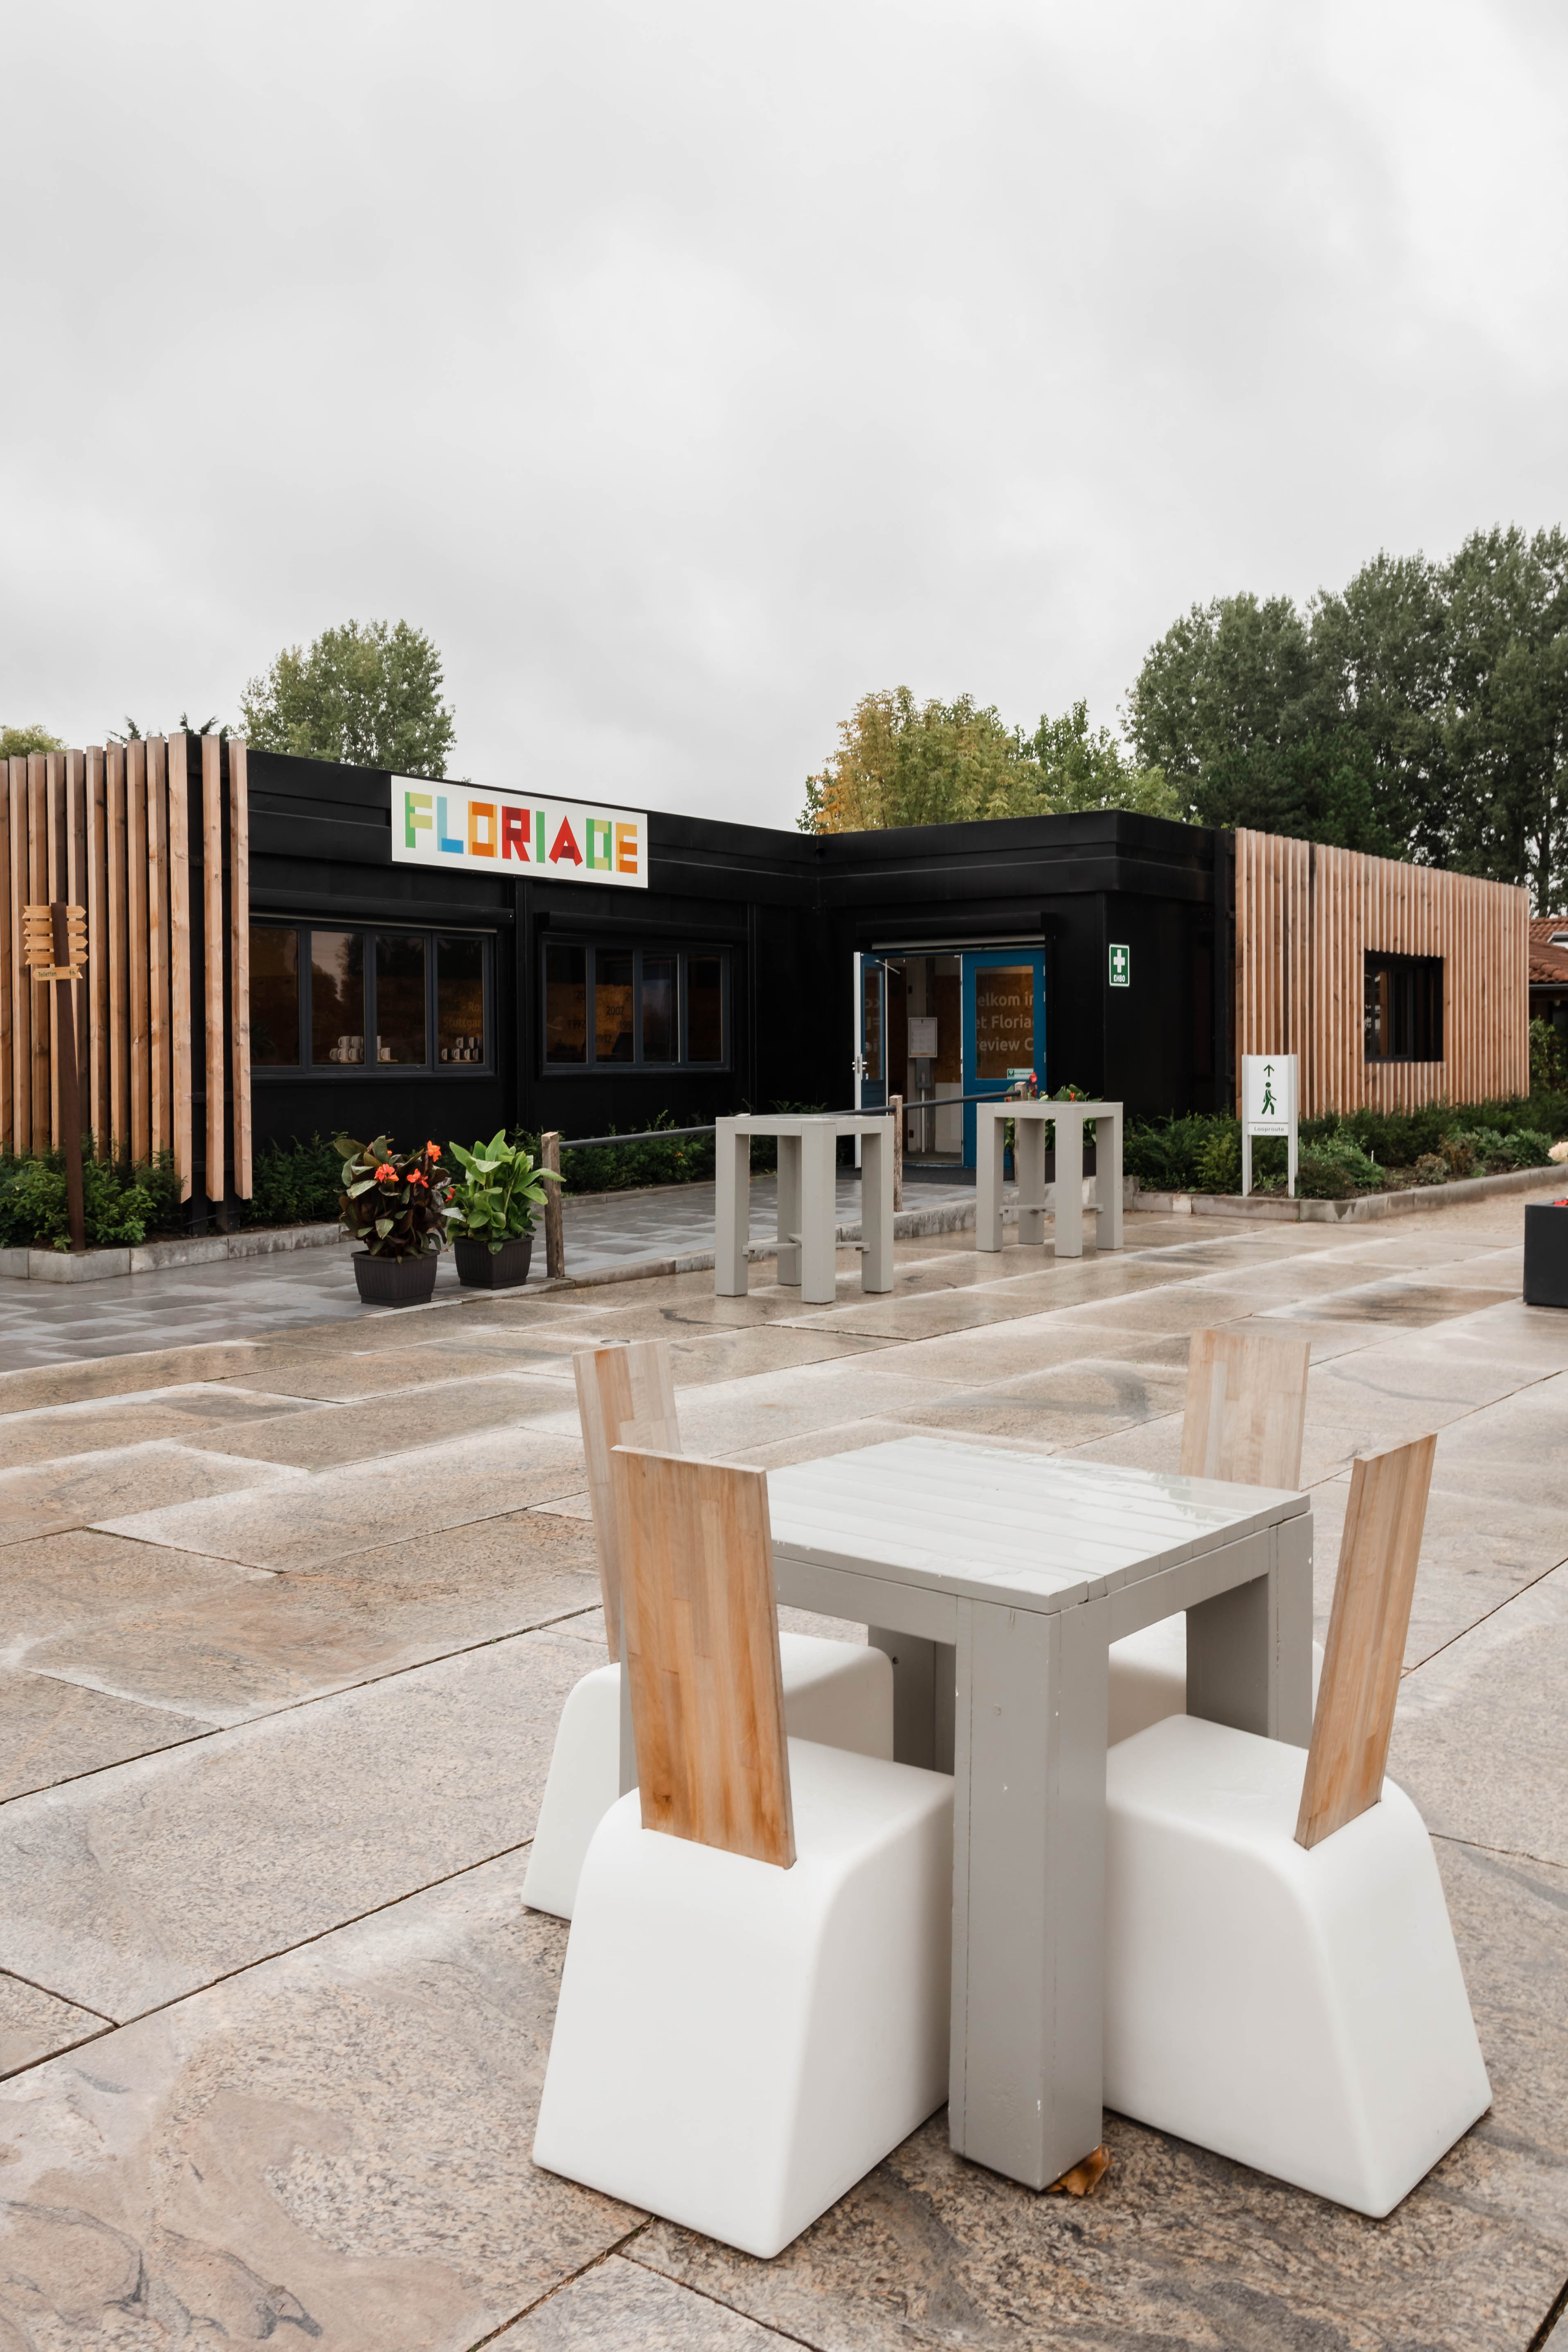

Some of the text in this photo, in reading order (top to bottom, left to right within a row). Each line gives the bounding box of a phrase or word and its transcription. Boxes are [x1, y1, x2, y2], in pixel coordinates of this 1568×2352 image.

[405, 792, 638, 874] FLORIADE
[1113, 974, 1125, 982] EHBO
[606, 1006, 624, 1016] 2002
[991, 1014, 1034, 1029] Floria
[977, 1036, 1020, 1051] eview
